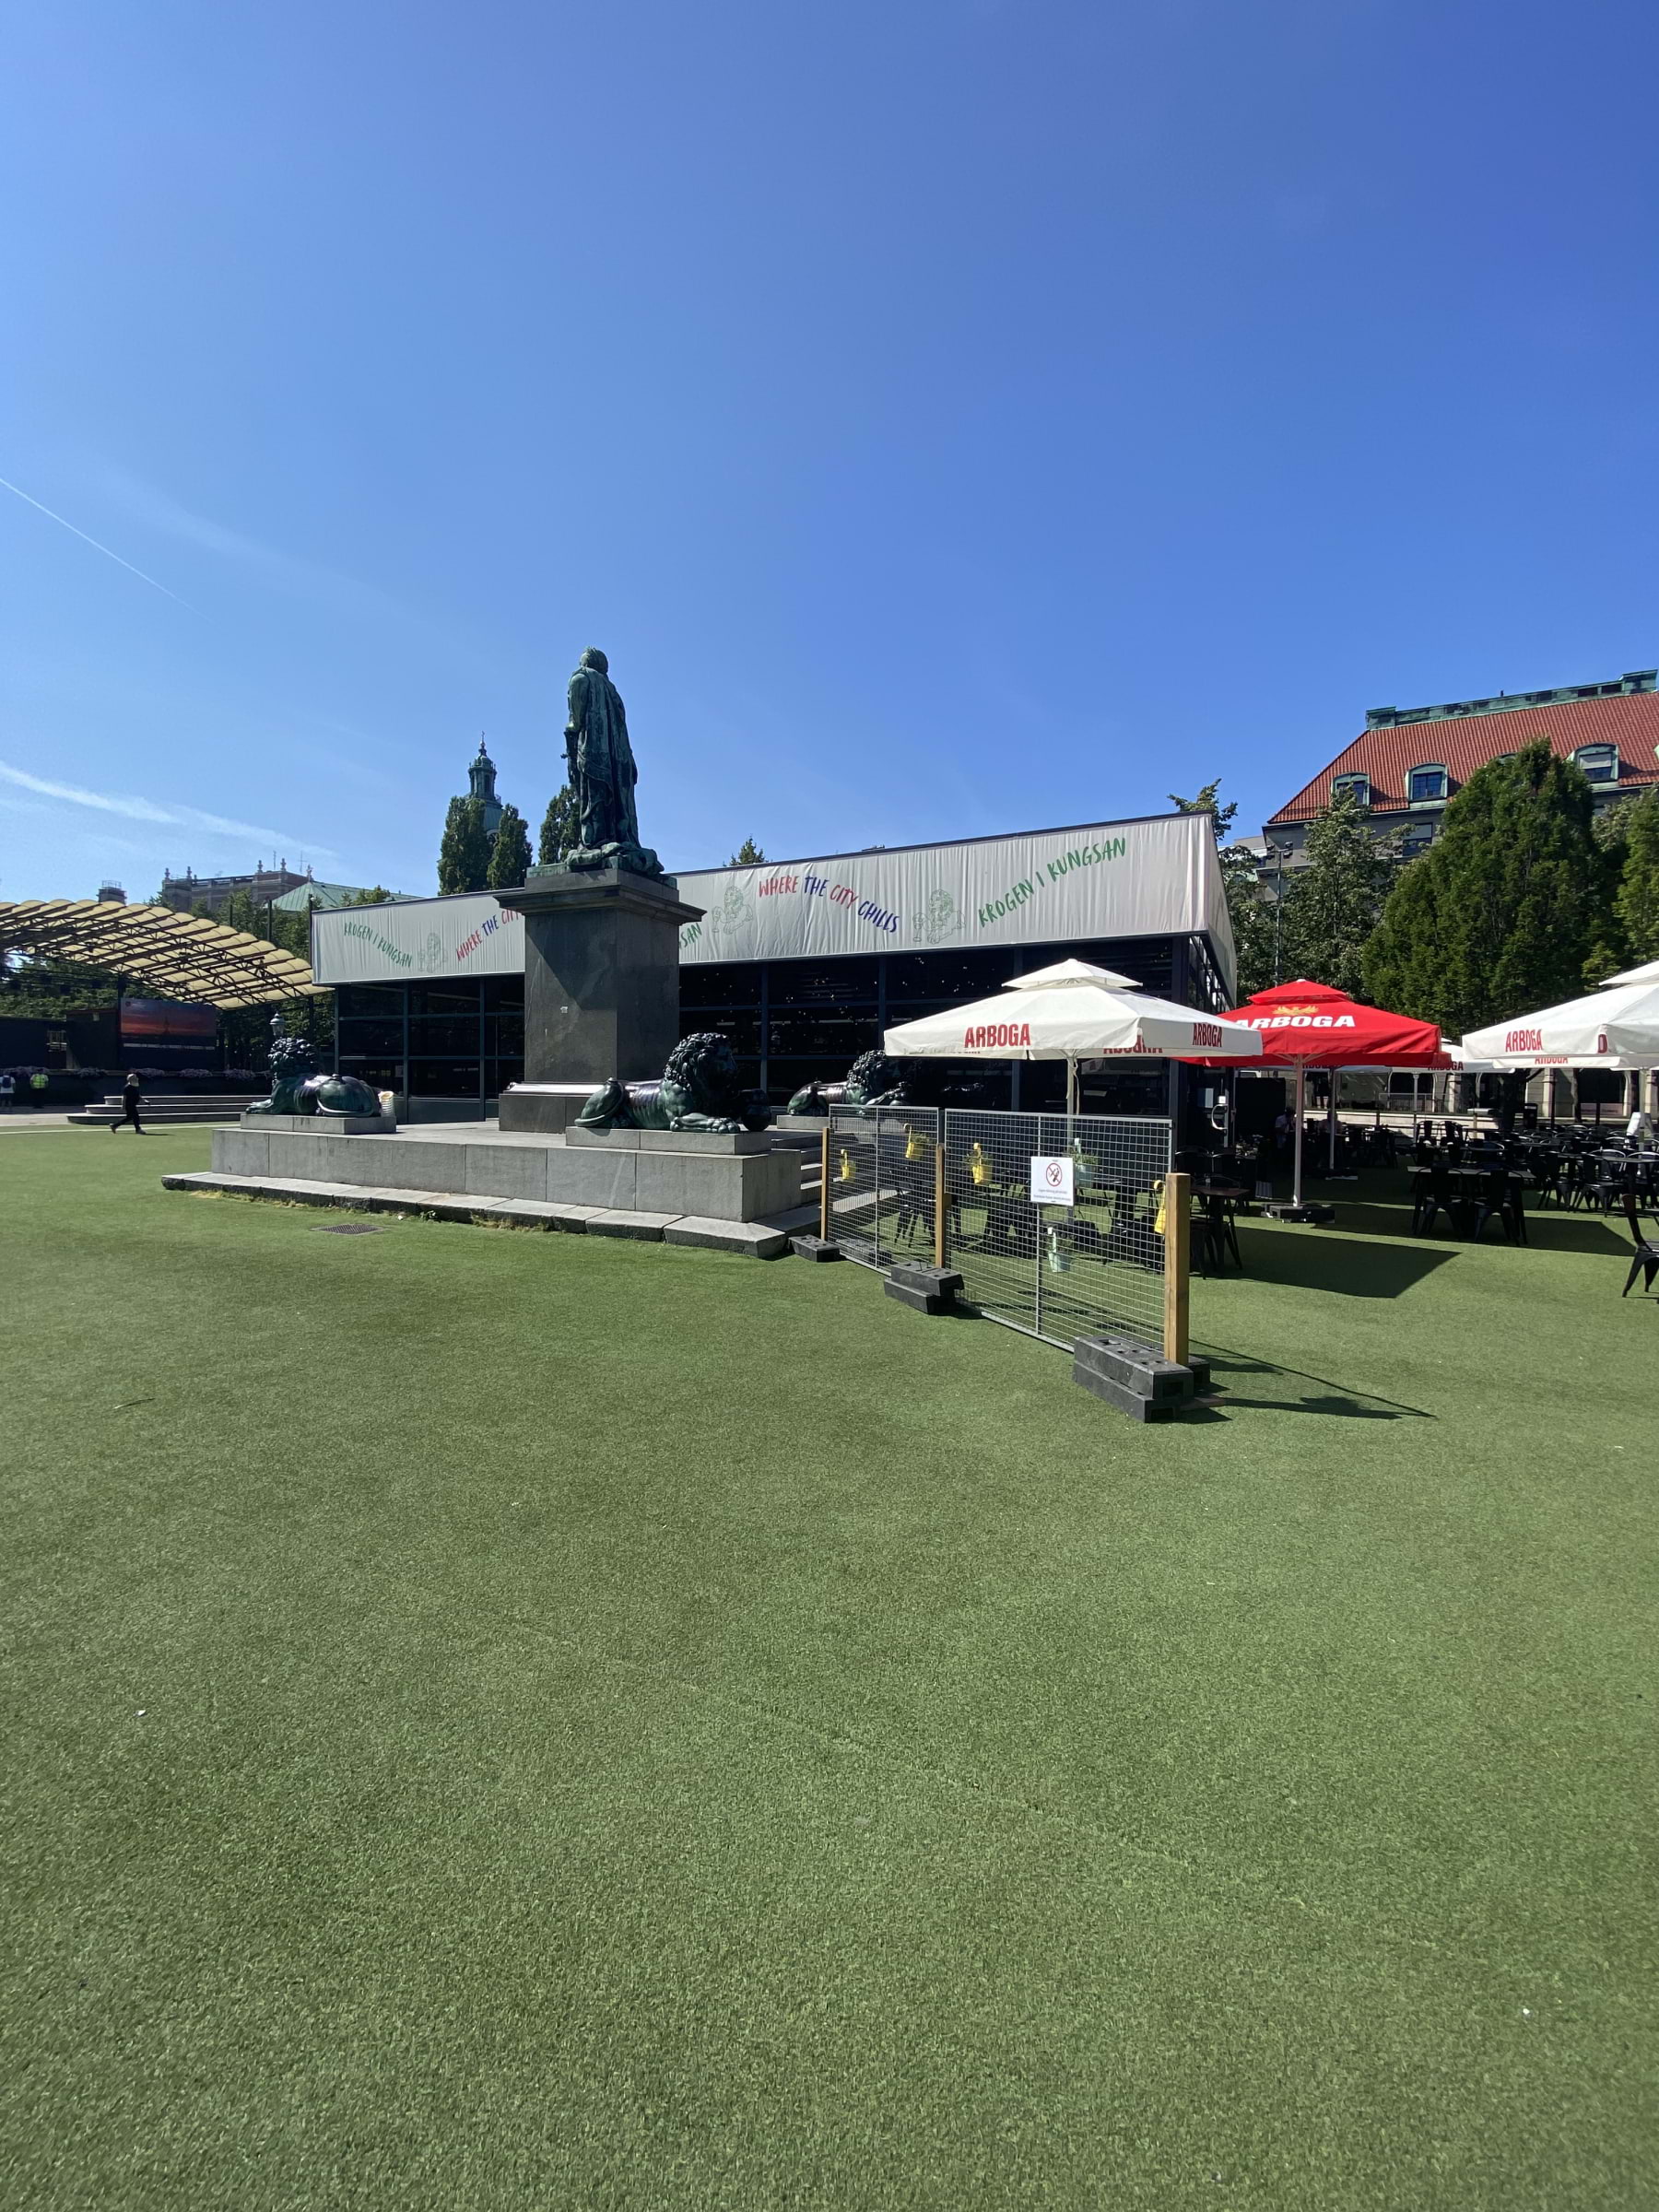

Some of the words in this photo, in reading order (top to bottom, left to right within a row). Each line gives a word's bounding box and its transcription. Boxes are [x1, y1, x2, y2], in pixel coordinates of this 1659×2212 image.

[978, 877, 1036, 929] KROGEN
[1035, 871, 1045, 888] I
[1047, 836, 1127, 884] KUNGSAN
[759, 875, 800, 898] WHERE
[804, 876, 830, 898] THE
[830, 884, 859, 910] CITY
[858, 900, 900, 933] CHILLS
[344, 921, 373, 941] KROGEN
[378, 937, 413, 969] KUNGSAN
[456, 929, 483, 962] WHERE
[481, 913, 500, 936] THE
[964, 1023, 1031, 1049] ARBOGA
[1192, 1022, 1223, 1048] ARBOGA
[1235, 1015, 1356, 1030] ARBOGA
[1505, 1028, 1544, 1053] ARBOGA
